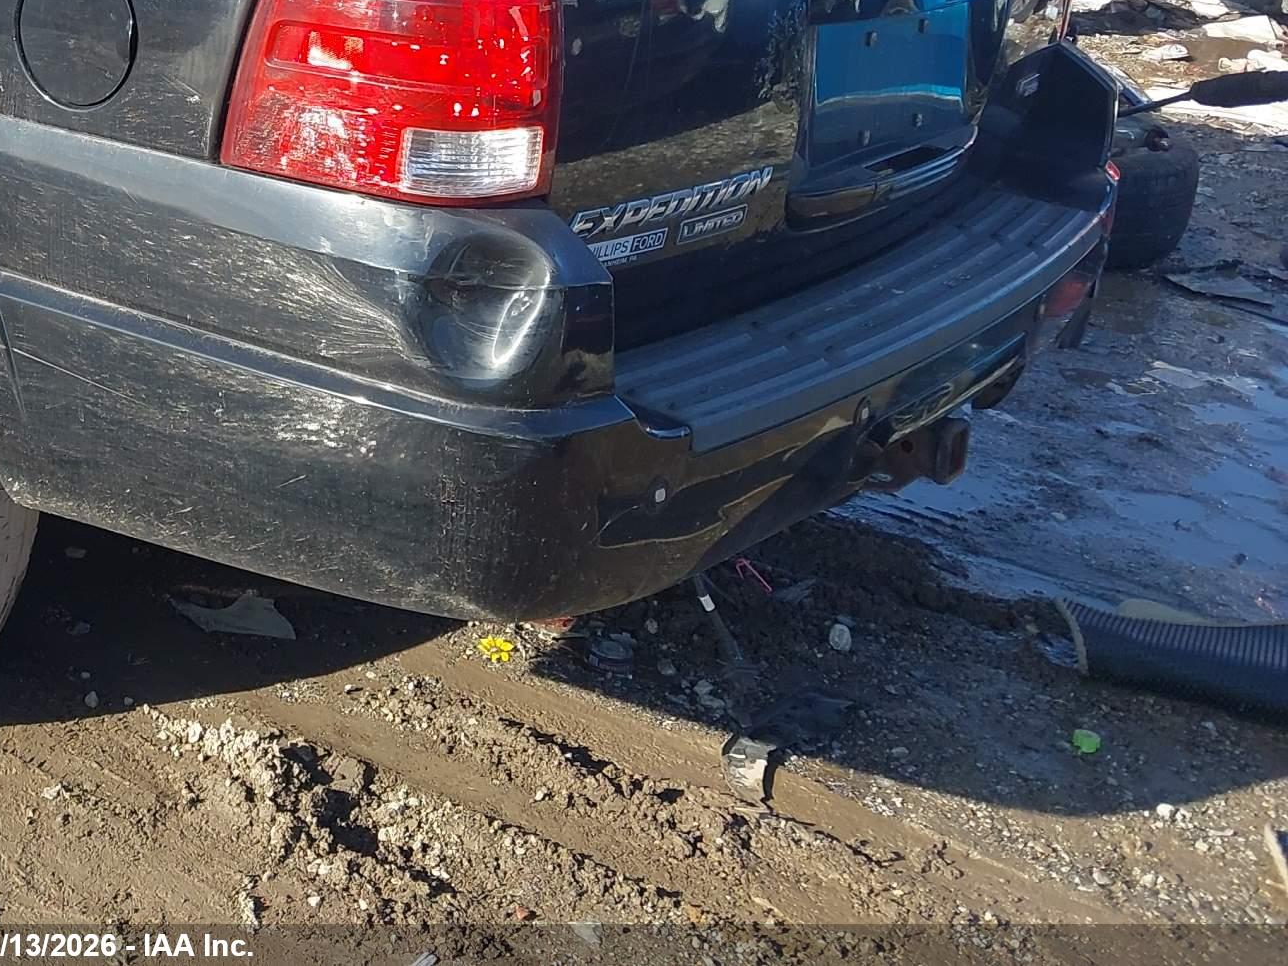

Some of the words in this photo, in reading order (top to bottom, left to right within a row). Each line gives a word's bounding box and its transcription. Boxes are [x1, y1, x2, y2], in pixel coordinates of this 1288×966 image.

[570, 166, 775, 238] EXPEDITION
[683, 209, 744, 238] LIMITED
[631, 232, 664, 252] FORD
